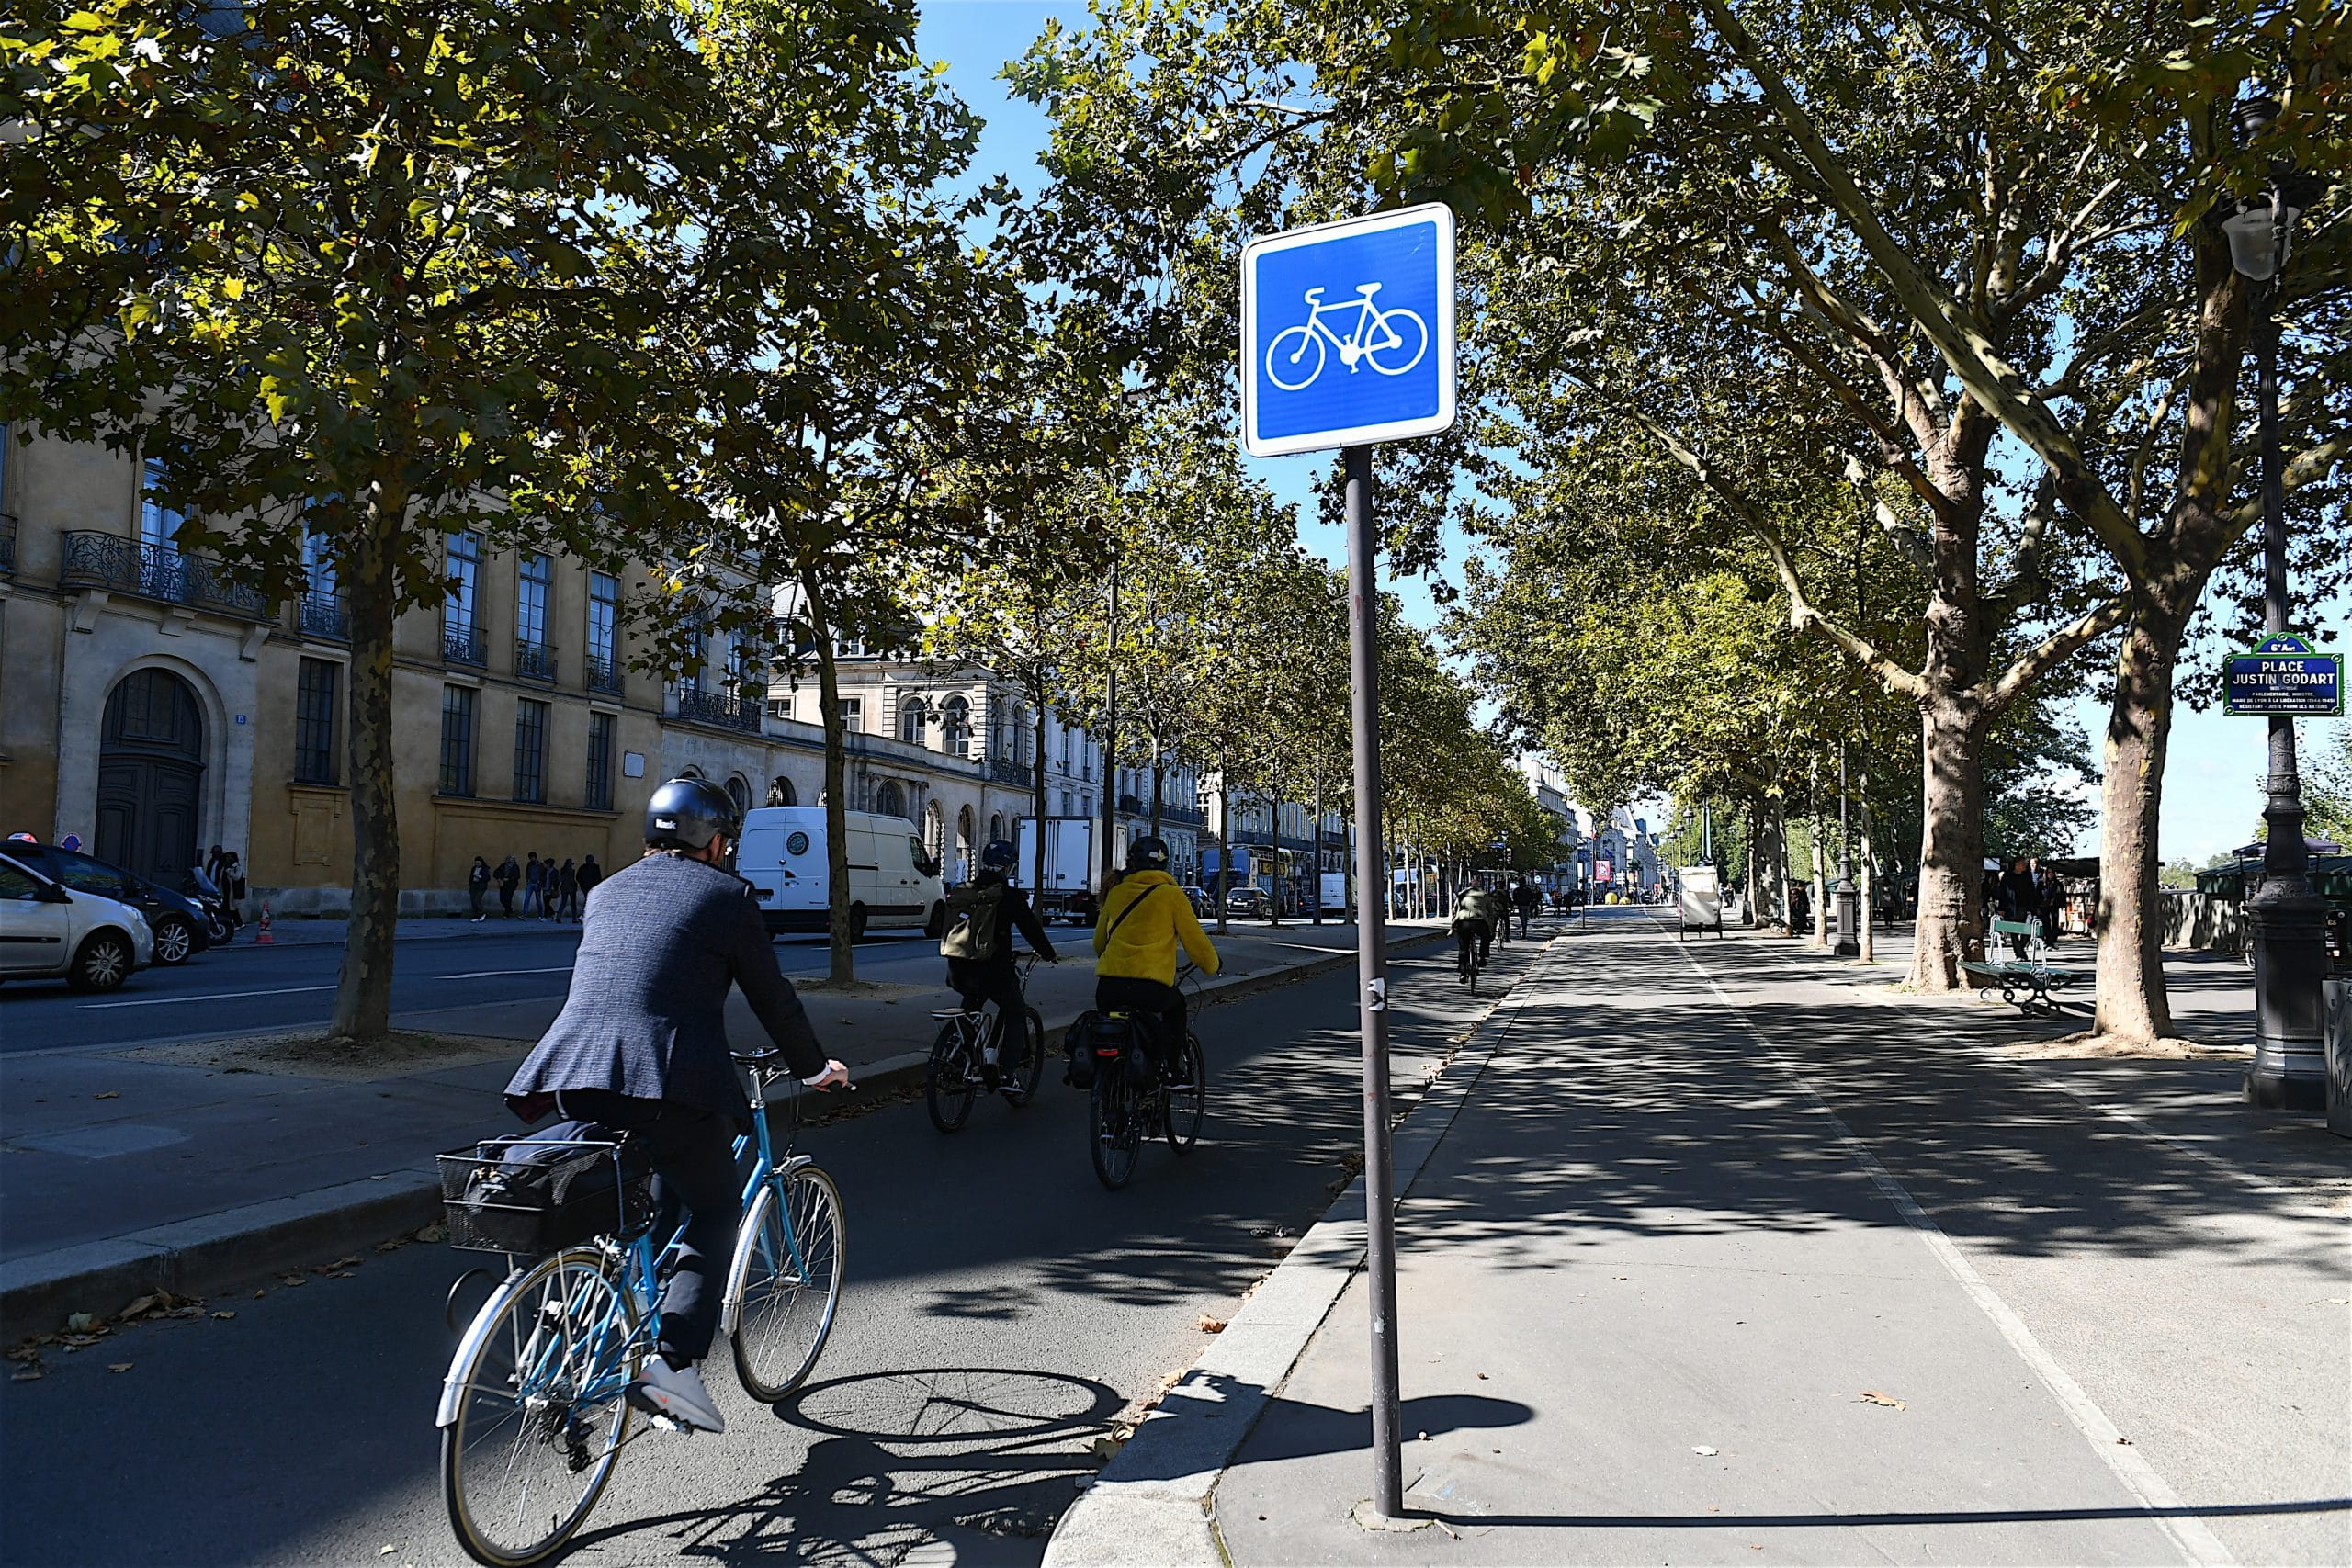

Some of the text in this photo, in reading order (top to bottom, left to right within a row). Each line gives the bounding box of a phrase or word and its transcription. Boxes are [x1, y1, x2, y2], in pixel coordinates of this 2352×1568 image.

[2261, 661, 2304, 672] PLACE
[2233, 673, 2335, 685] JUSTIN GODART
